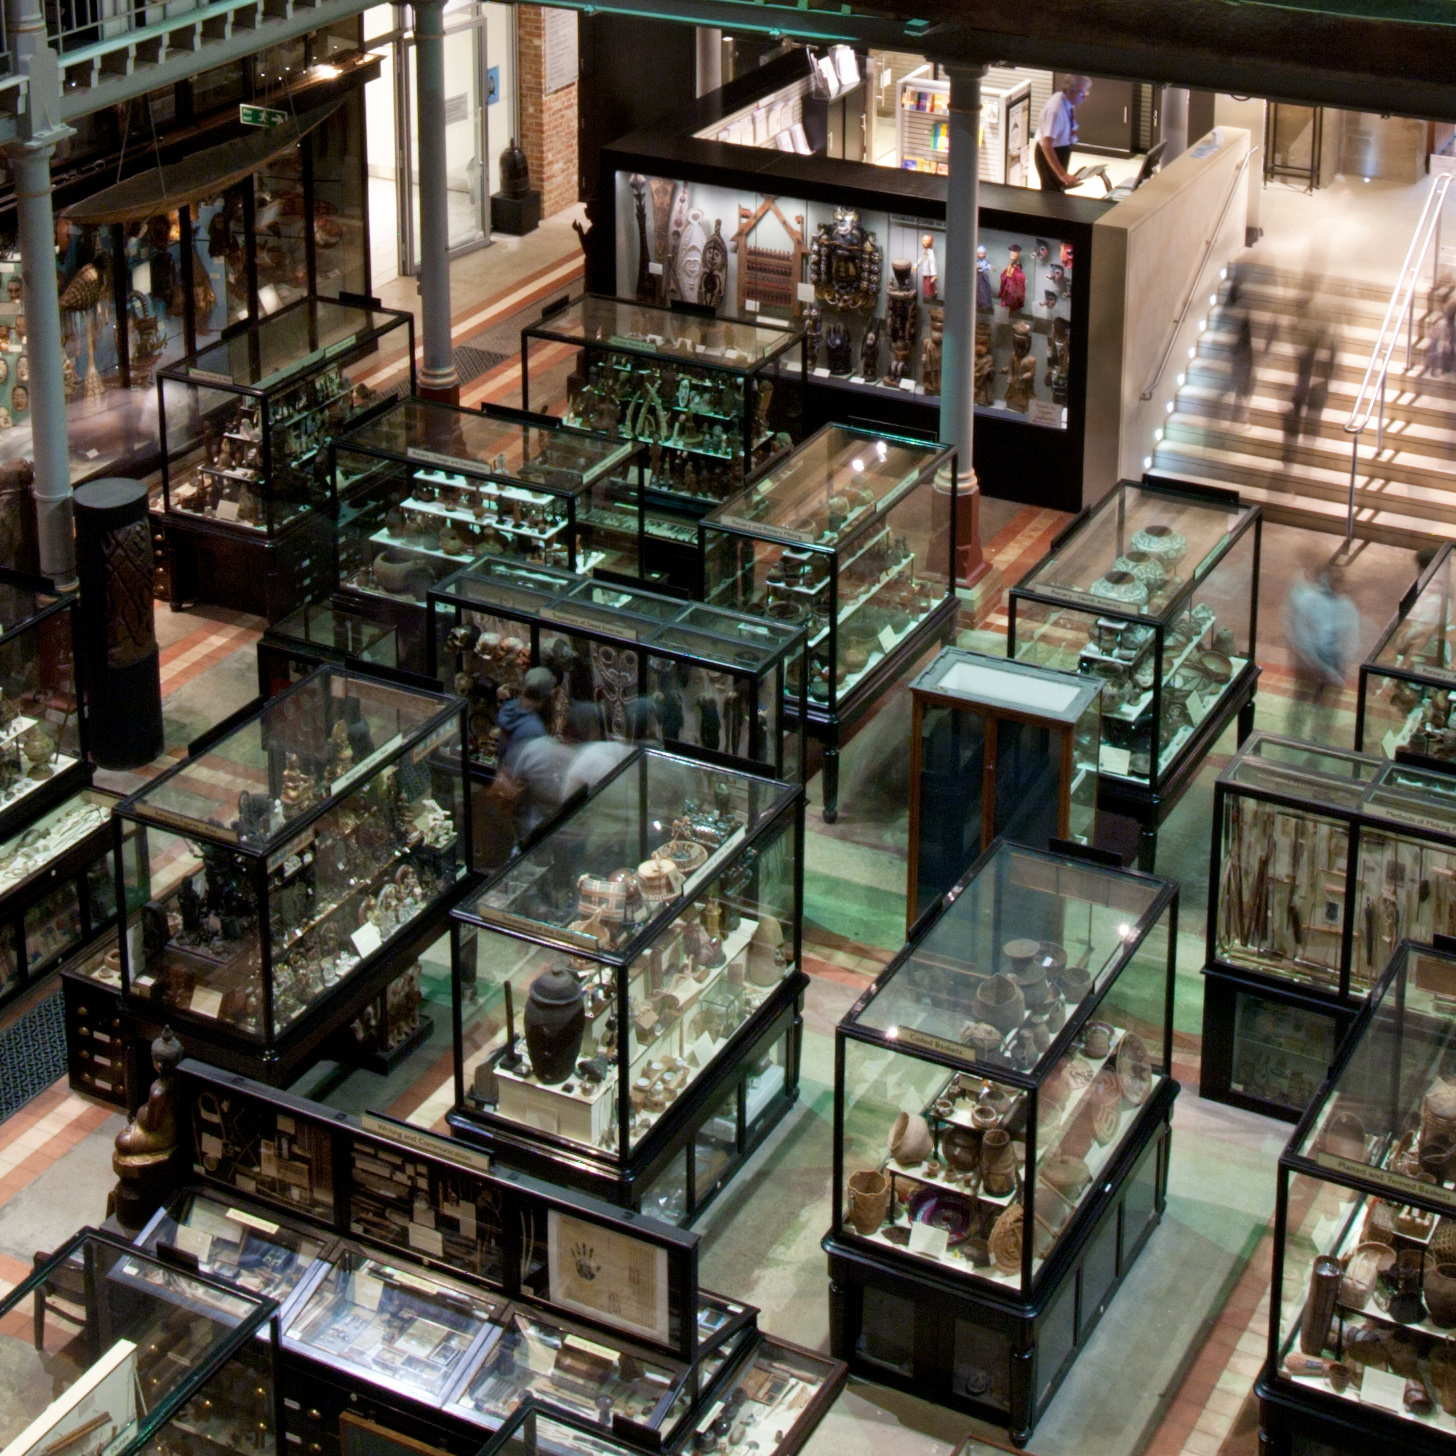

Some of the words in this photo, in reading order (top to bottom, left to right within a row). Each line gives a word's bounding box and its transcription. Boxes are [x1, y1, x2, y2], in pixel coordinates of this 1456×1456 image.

[1423, 667, 1446, 679] Pottery
[1386, 810, 1416, 823] Methods
[1426, 820, 1450, 833] Making
[910, 1033, 933, 1045] Coiled
[935, 1041, 962, 1055] Baskets
[377, 1123, 403, 1140] Writing
[405, 1133, 417, 1143] and
[418, 1137, 472, 1162] Communication
[1338, 1162, 1367, 1177] Plaited
[1369, 1170, 1384, 1181] and
[1387, 1176, 1416, 1192] Twined
[1418, 1184, 1451, 1201] Baskets
[108, 1434, 130, 1453] Flutes
